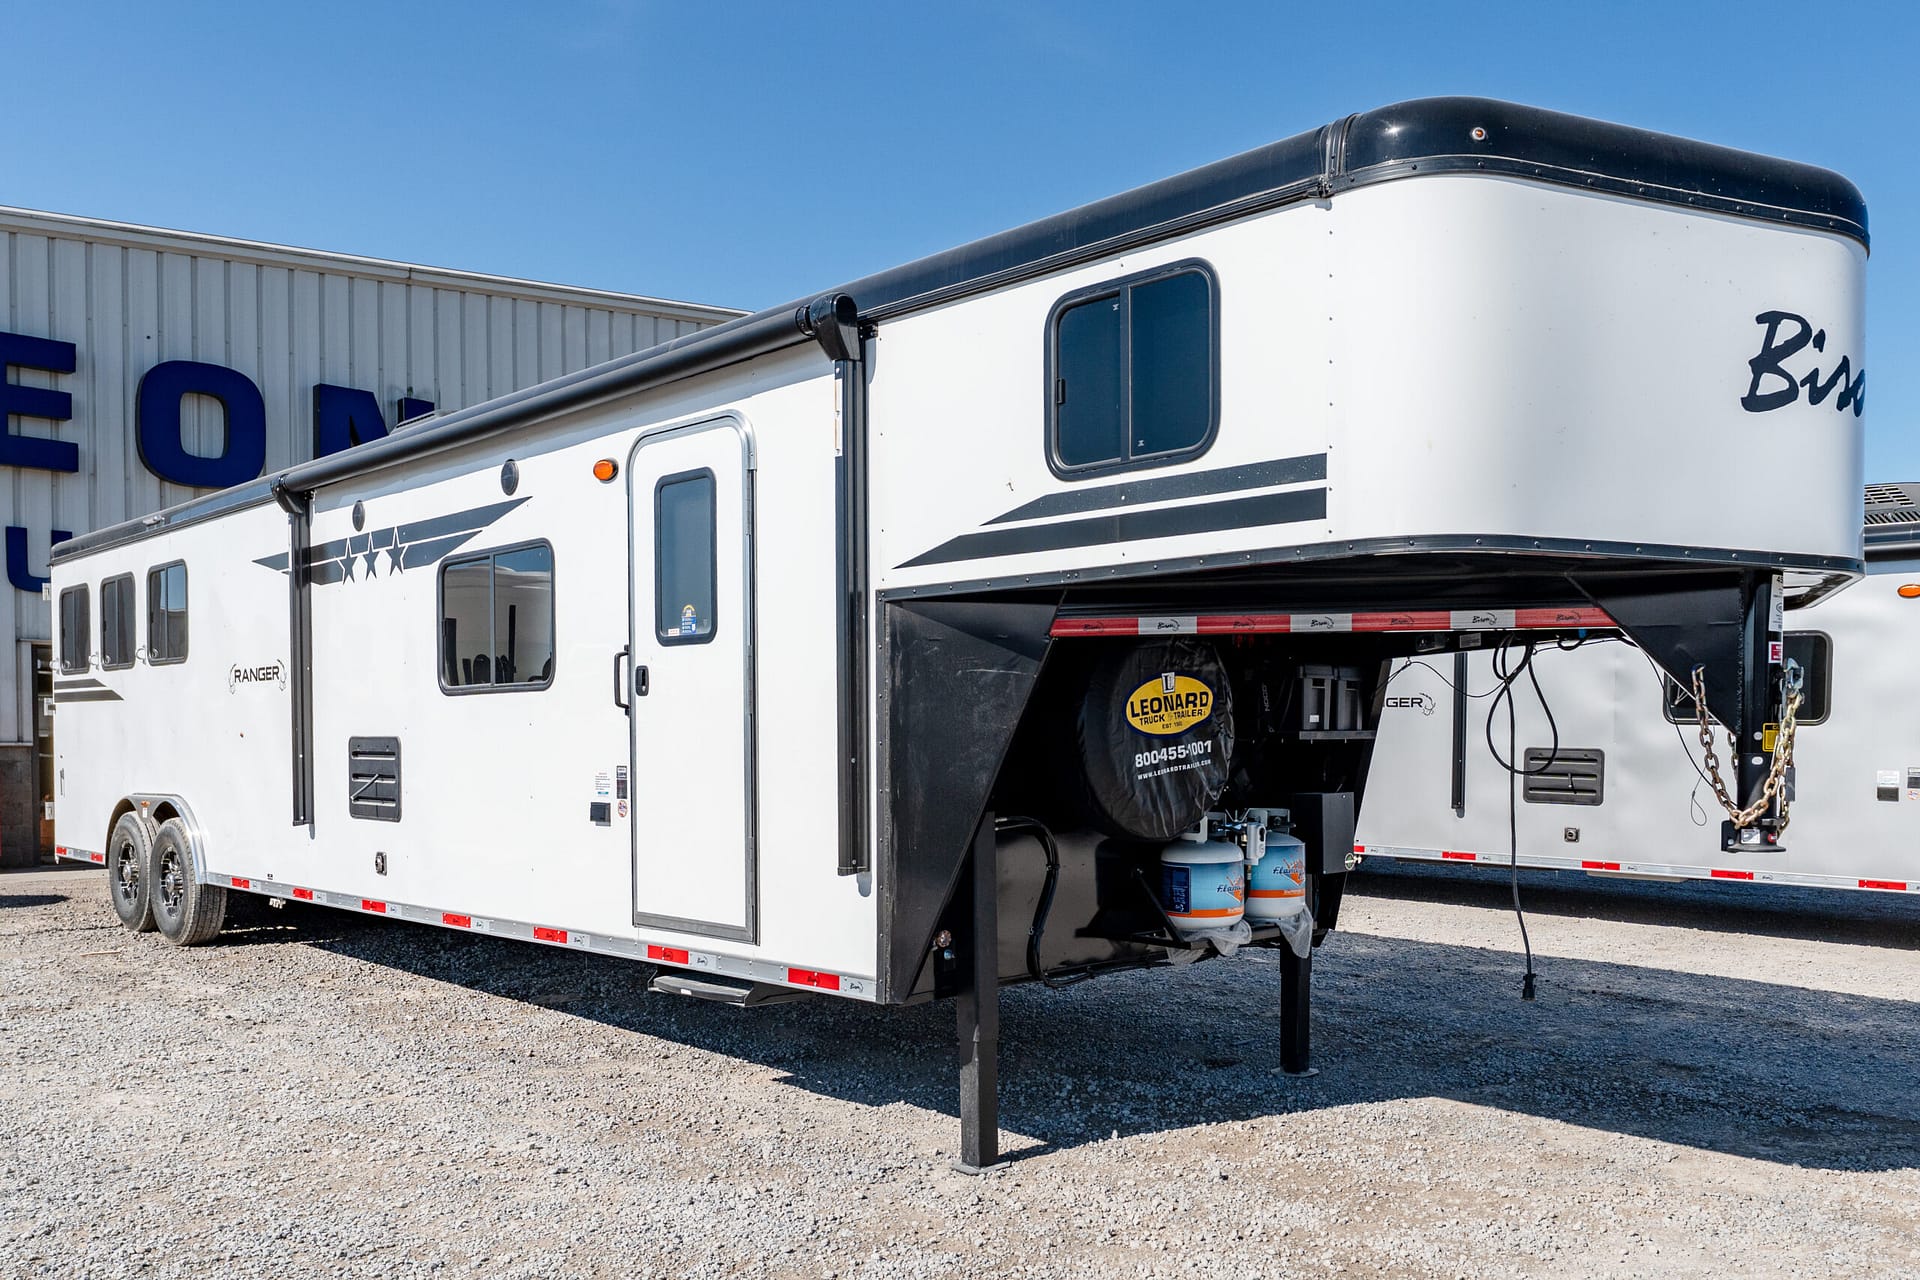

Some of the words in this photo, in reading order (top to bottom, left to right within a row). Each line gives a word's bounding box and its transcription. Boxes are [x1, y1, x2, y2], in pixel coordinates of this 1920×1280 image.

[234, 665, 280, 683] RANGER
[1130, 691, 1209, 718] LEONARD
[1139, 713, 1166, 726] TRUCK
